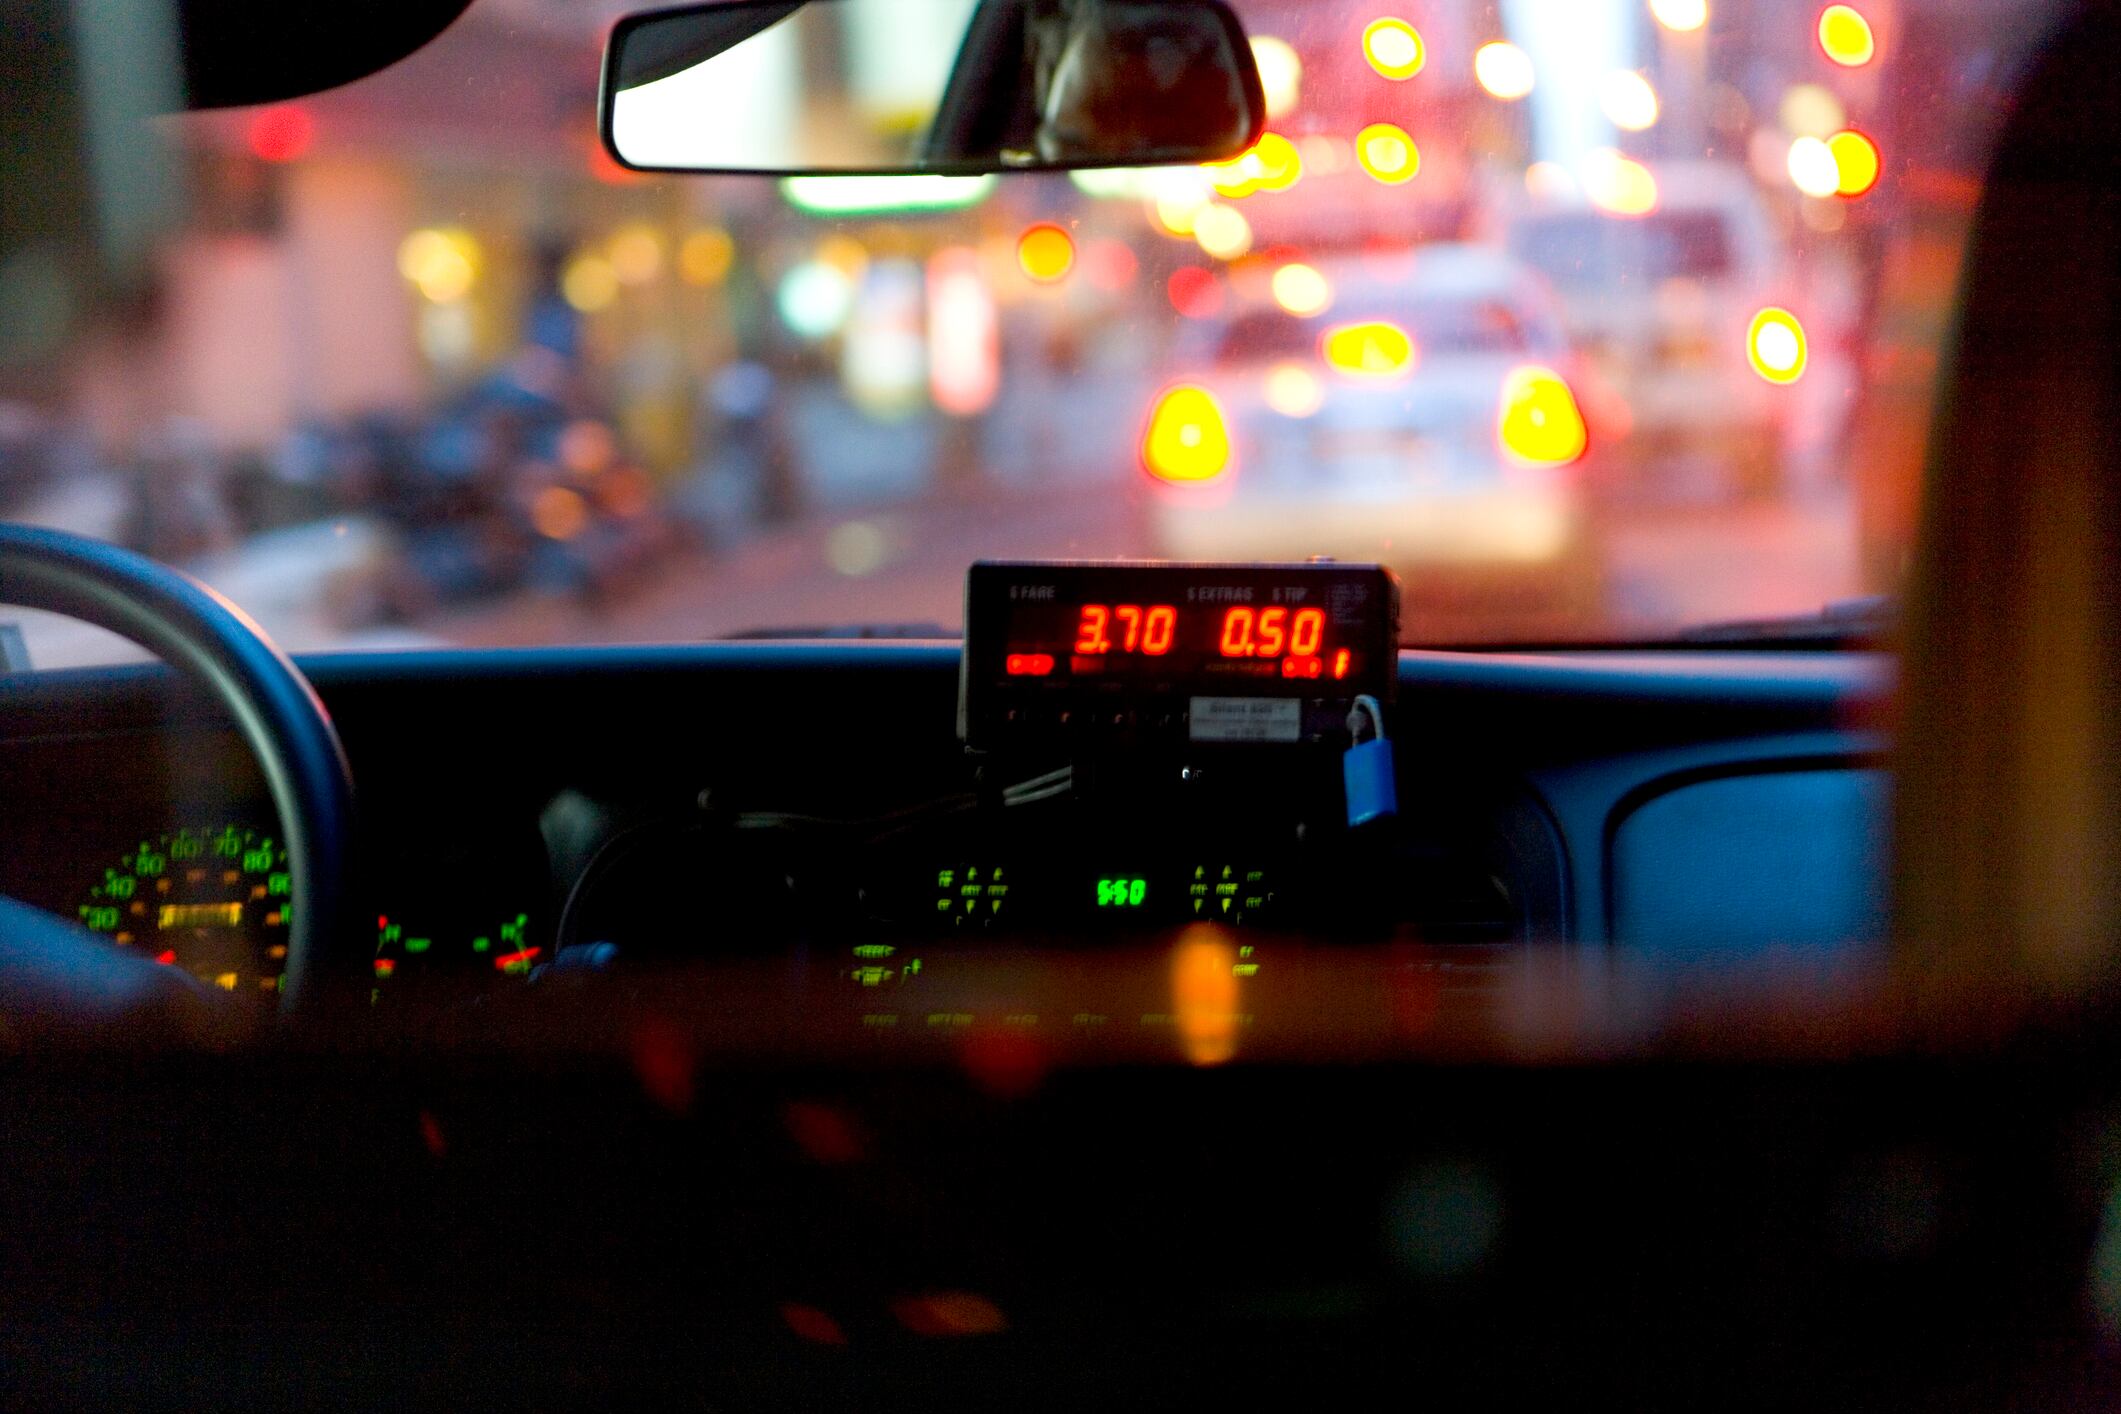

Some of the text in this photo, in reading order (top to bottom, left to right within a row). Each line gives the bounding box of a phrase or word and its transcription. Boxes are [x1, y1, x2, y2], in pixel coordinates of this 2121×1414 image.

[1021, 585, 1055, 601] FARE
[1198, 586, 1254, 602] EXTRAS
[1075, 605, 1177, 655] 3.70
[1220, 606, 1325, 657] 0.50
